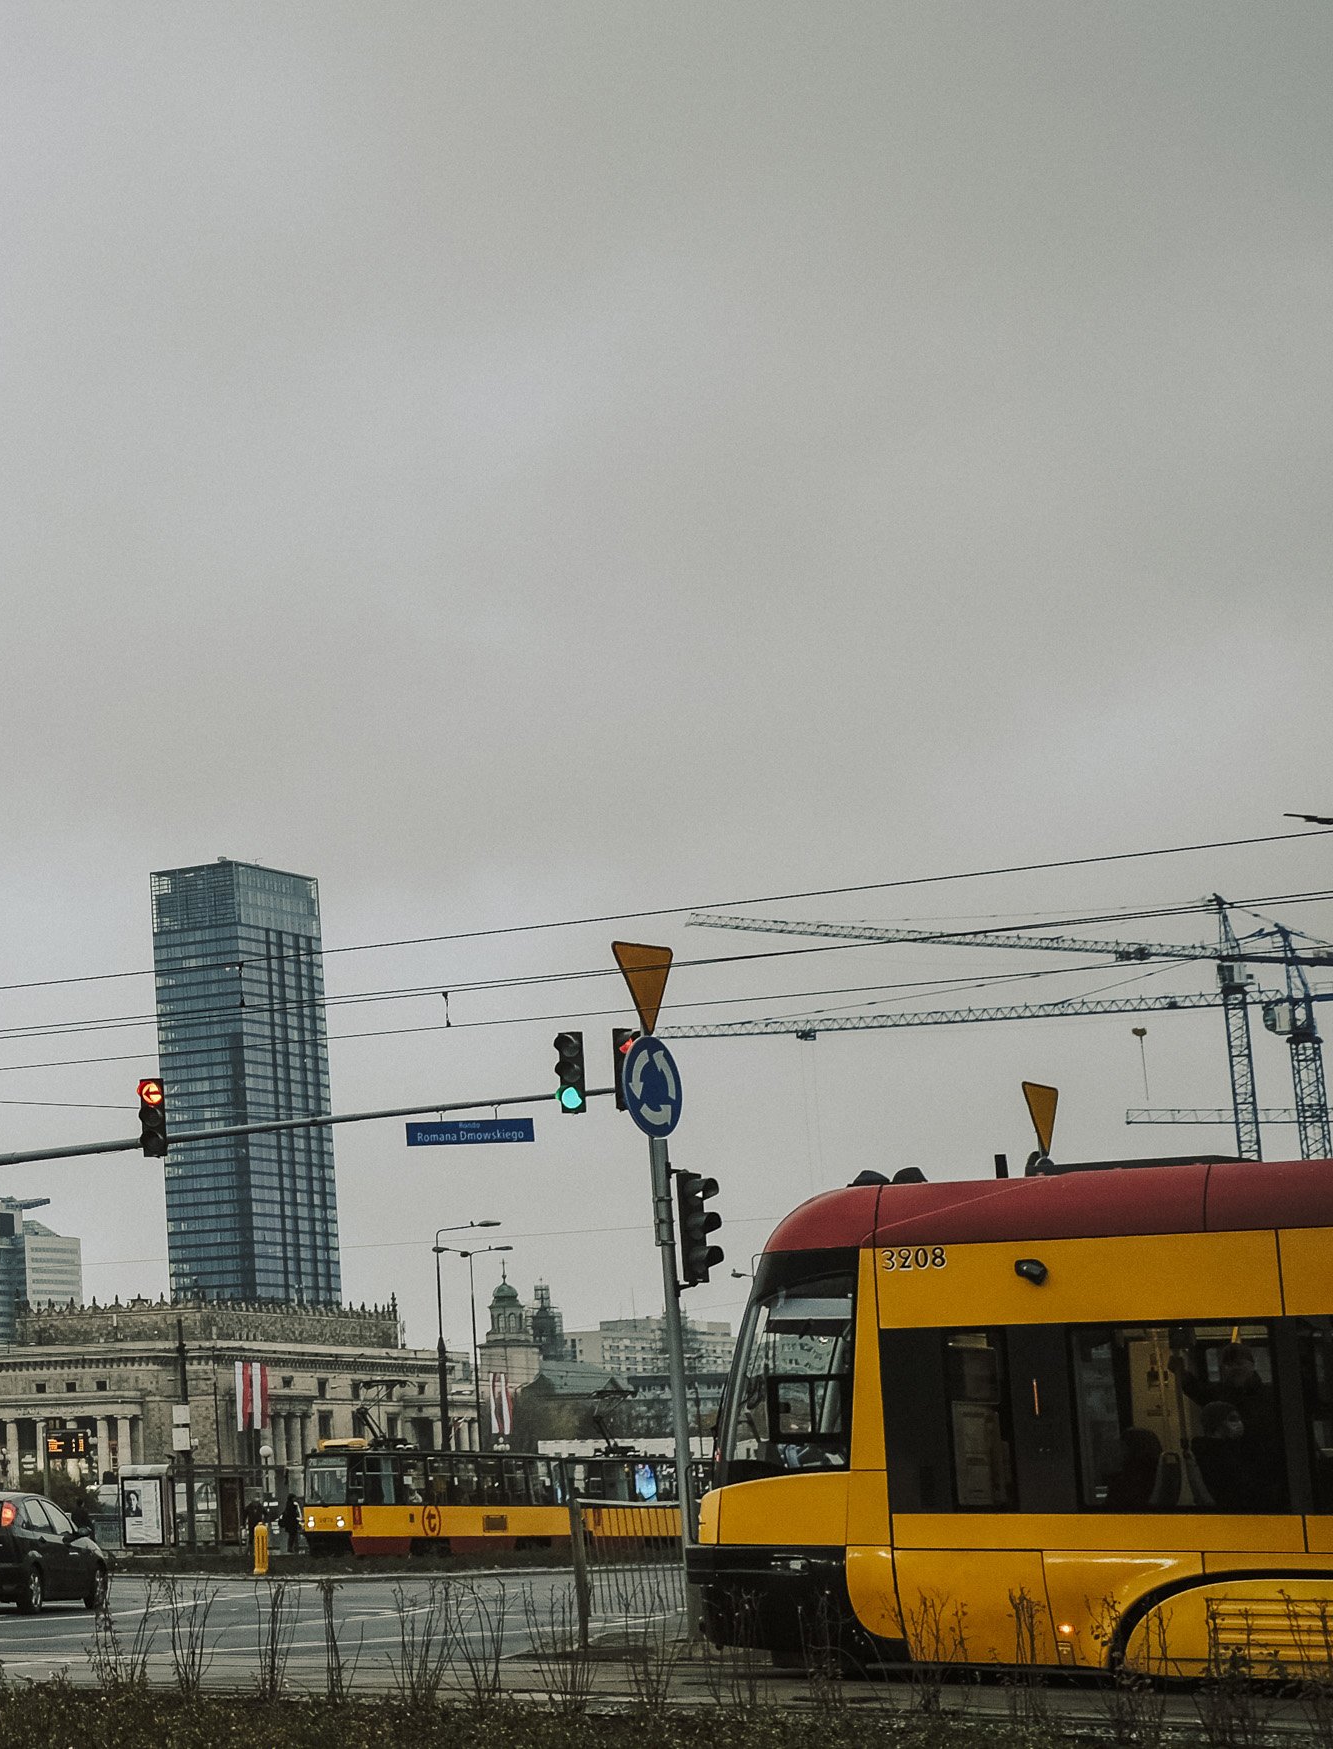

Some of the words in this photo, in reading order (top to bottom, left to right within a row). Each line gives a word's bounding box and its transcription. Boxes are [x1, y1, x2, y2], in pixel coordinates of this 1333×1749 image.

[458, 1121, 481, 1129] Rondo
[417, 1132, 457, 1142] Romana
[459, 1129, 524, 1143] Dmowskiego
[881, 1246, 947, 1272] 3208
